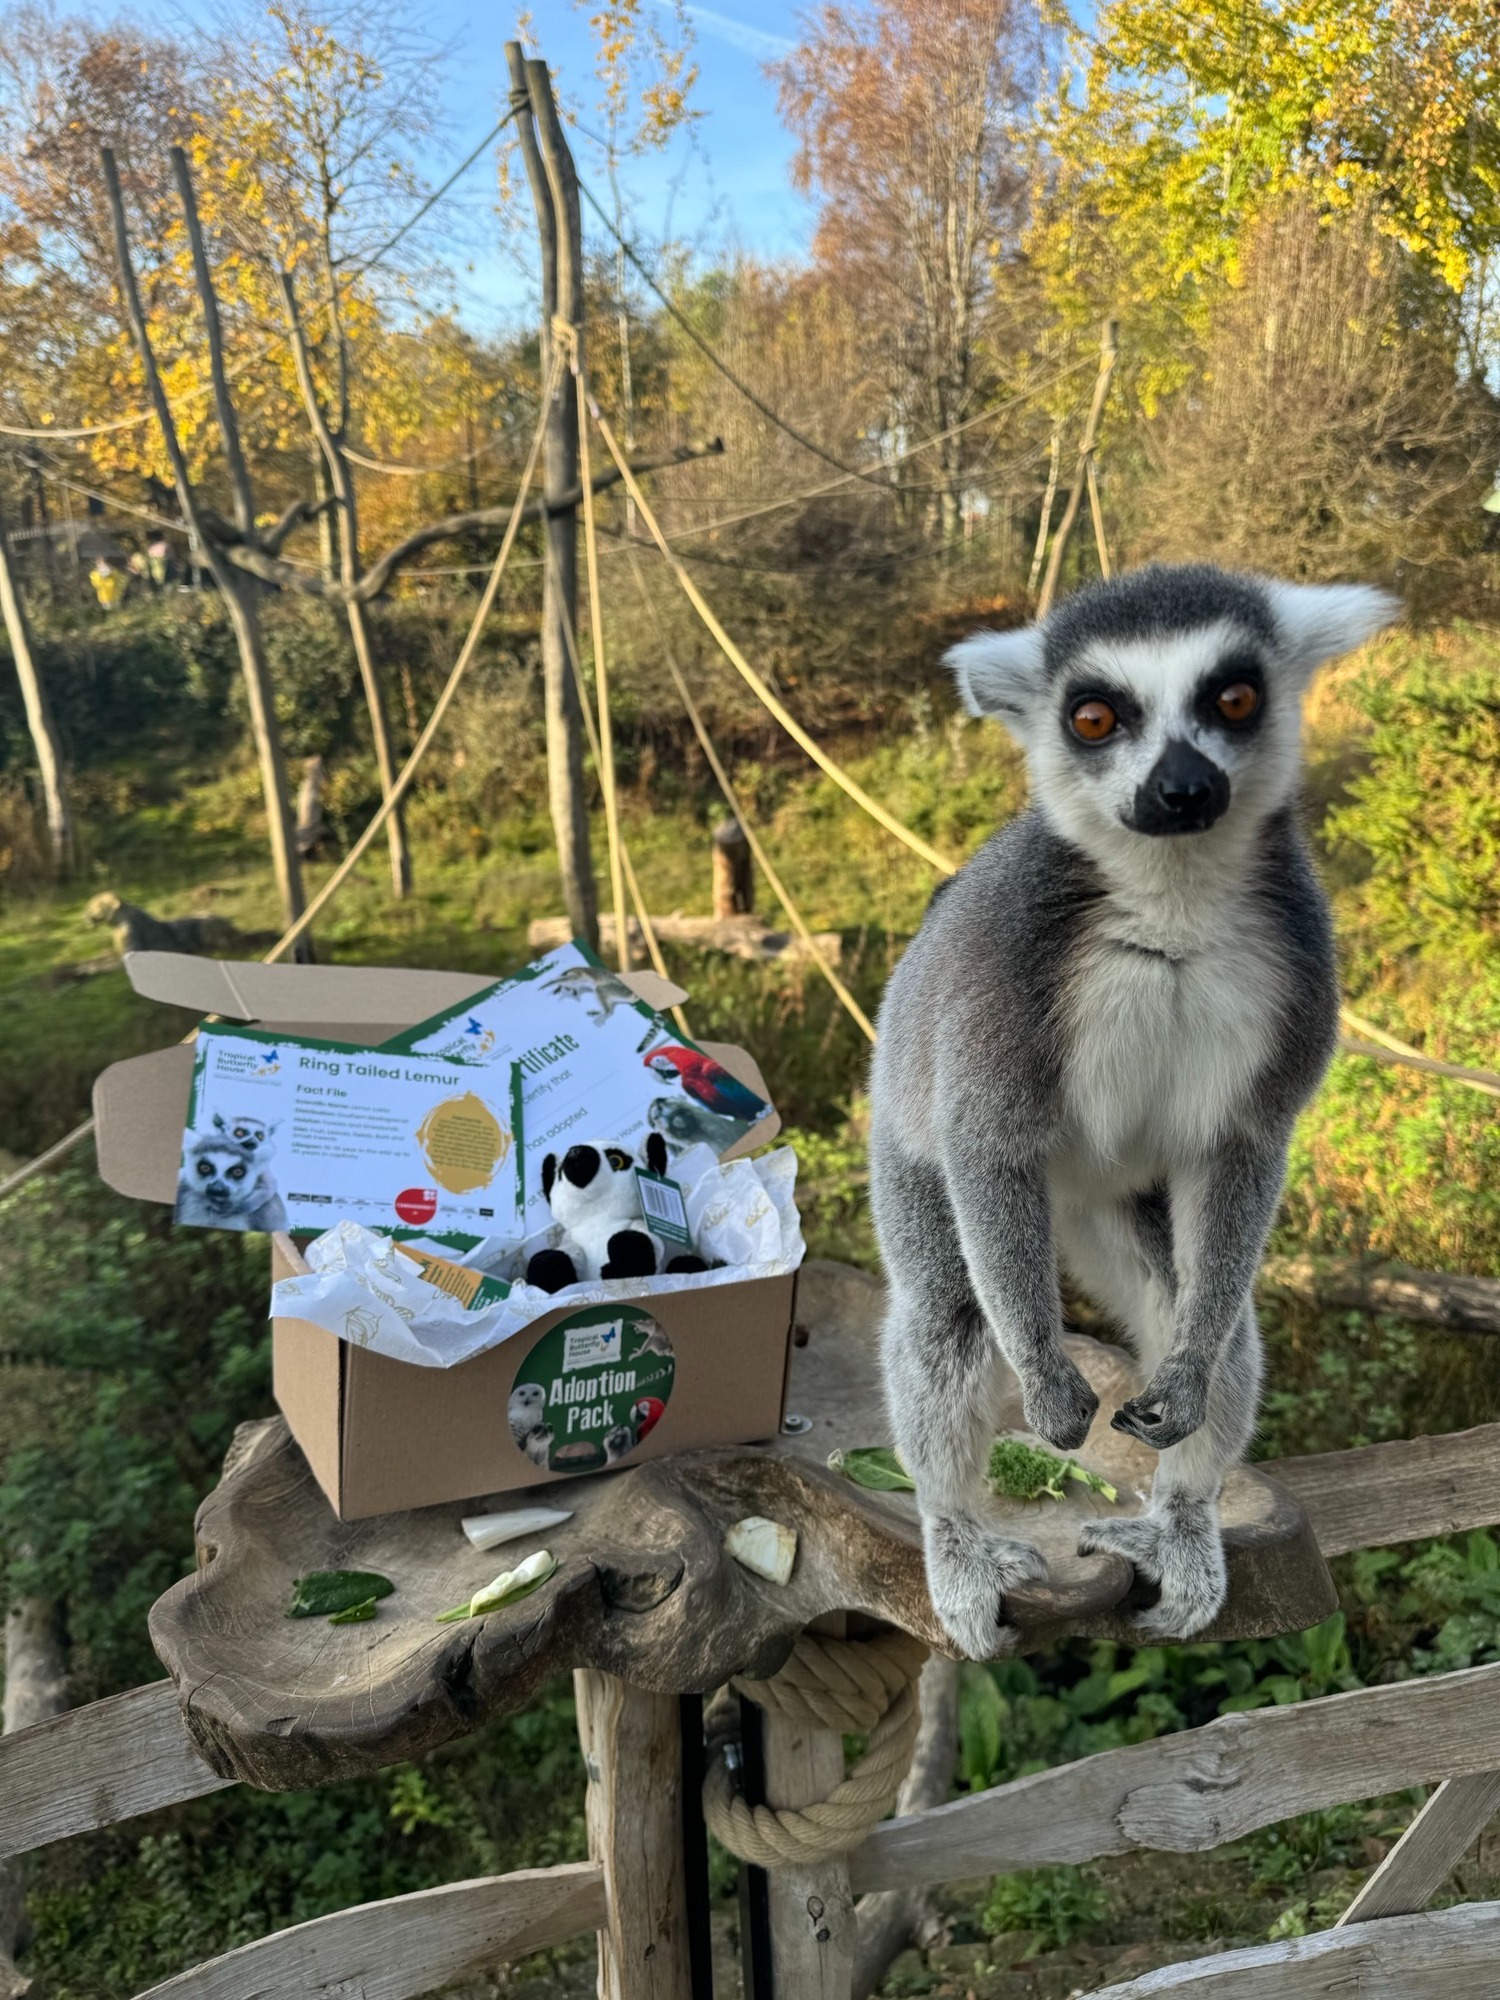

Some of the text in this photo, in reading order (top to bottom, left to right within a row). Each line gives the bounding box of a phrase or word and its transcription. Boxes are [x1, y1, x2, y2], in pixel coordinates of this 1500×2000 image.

[218, 1049, 256, 1062] Tropical
[216, 1064, 246, 1073] House
[217, 1057, 259, 1070] Butterfly
[299, 1056, 461, 1086] Ring Tailed Lemur
[549, 1069, 574, 1087] that
[296, 1084, 348, 1098] Fact File
[525, 1134, 547, 1151] has
[546, 1106, 589, 1137] adopted
[569, 1340, 600, 1351] Butterfly
[570, 1333, 599, 1345] Tropical
[568, 1348, 591, 1358] House
[549, 1369, 637, 1407] Adoption
[566, 1400, 614, 1434] Pack
